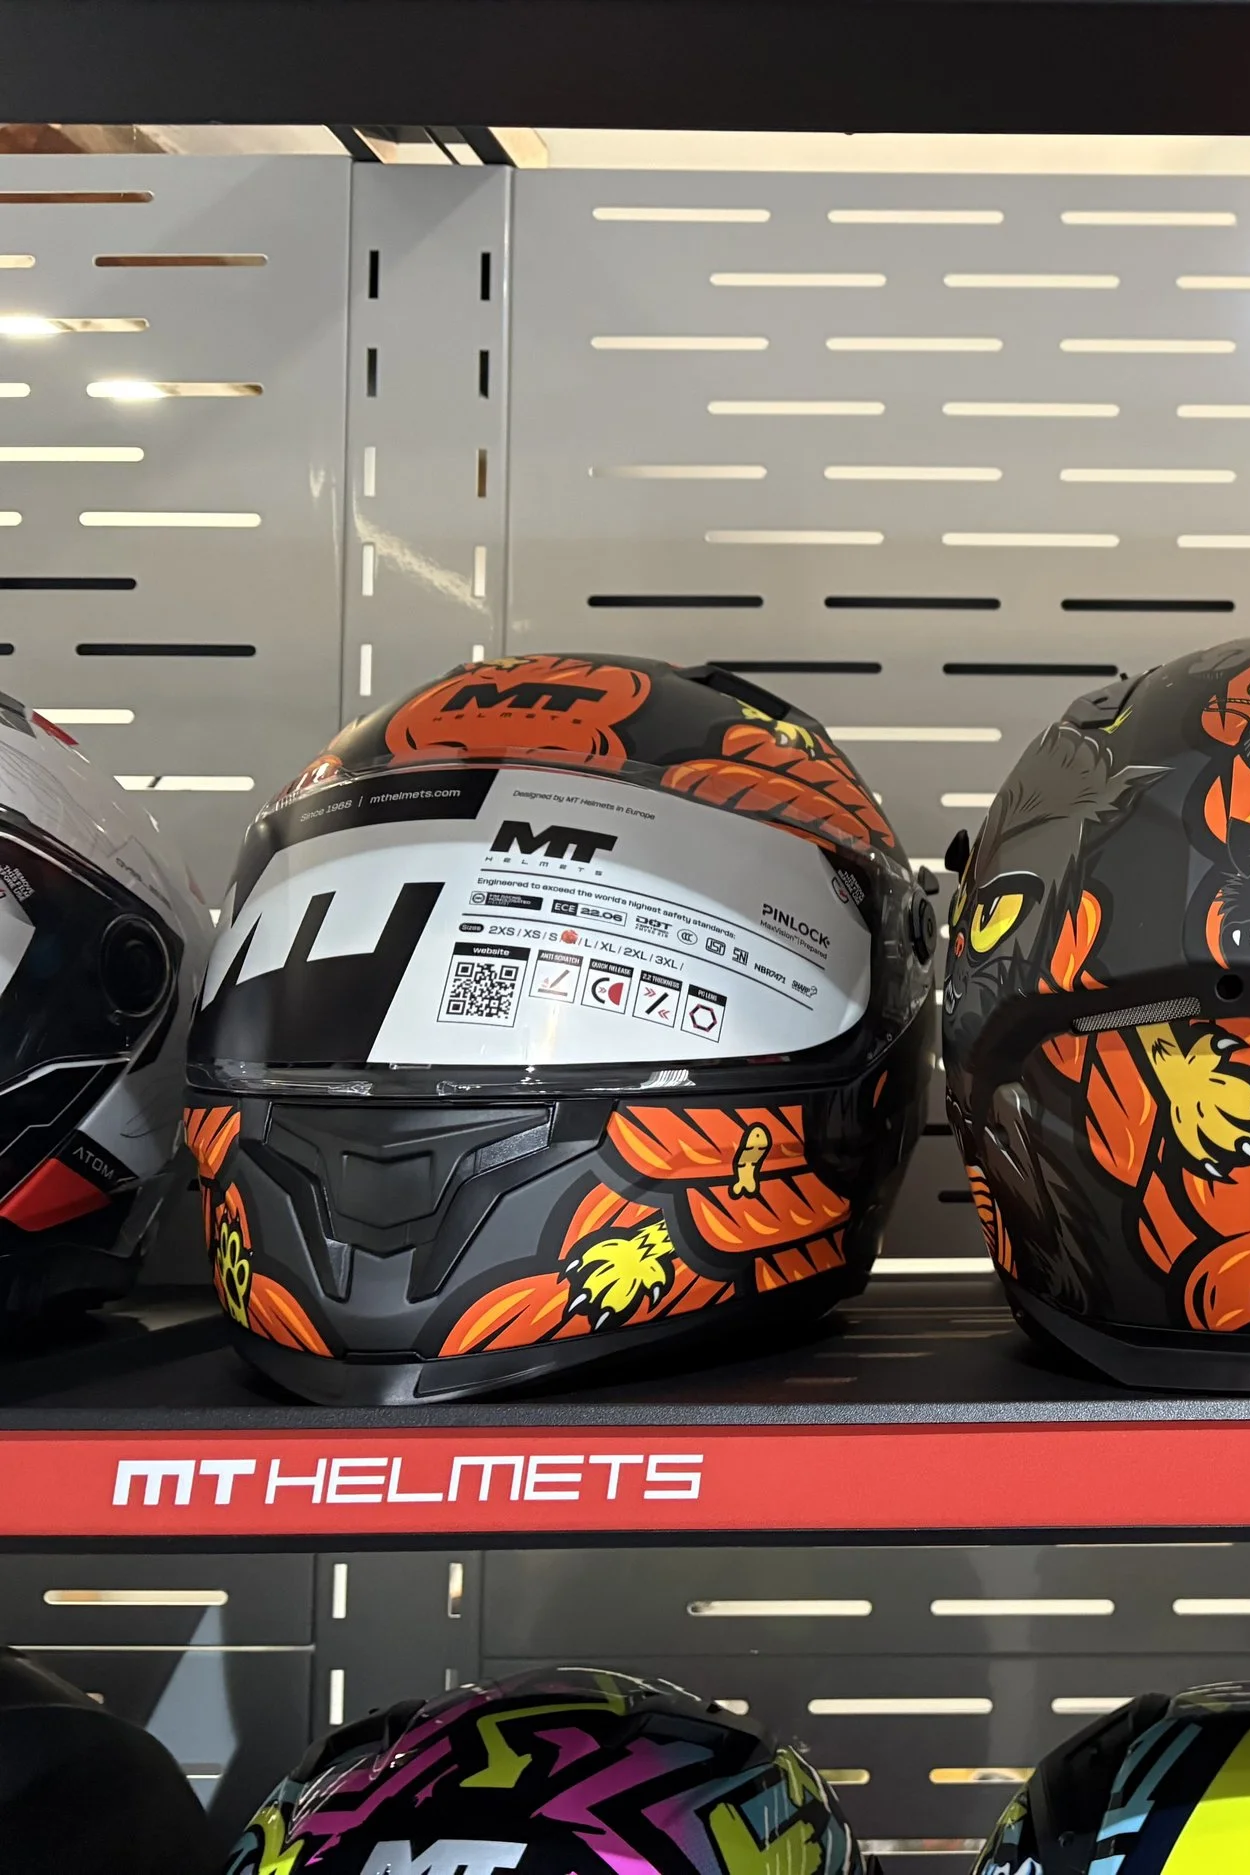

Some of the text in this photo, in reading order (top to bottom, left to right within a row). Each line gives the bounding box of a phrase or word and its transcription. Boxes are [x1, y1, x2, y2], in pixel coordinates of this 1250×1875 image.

[440, 682, 608, 712] MT
[433, 712, 583, 725] HELMETS
[300, 808, 325, 822] Since
[325, 799, 353, 814] 1968
[369, 788, 461, 804] mthelmets.com
[512, 790, 552, 801] Designed
[553, 794, 565, 803] by
[566, 796, 579, 804] MT
[580, 799, 615, 811] Helmets
[625, 807, 656, 820] Europe
[490, 820, 618, 864] MT
[485, 856, 603, 876] HELMETS
[477, 877, 736, 940] Engineered to exceed the world's highest safety standards:
[554, 902, 623, 923] ECE 22.06
[636, 915, 673, 930] DOT
[762, 903, 831, 949] PINLOCK
[472, 946, 511, 957] website
[488, 925, 515, 937] 2XS
[523, 929, 542, 940] XS
[600, 942, 616, 954] XL
[623, 947, 647, 961] 2XL
[655, 954, 678, 970] 3XL
[754, 962, 787, 985] NBR7471
[72, 1146, 115, 1180] ATOM
